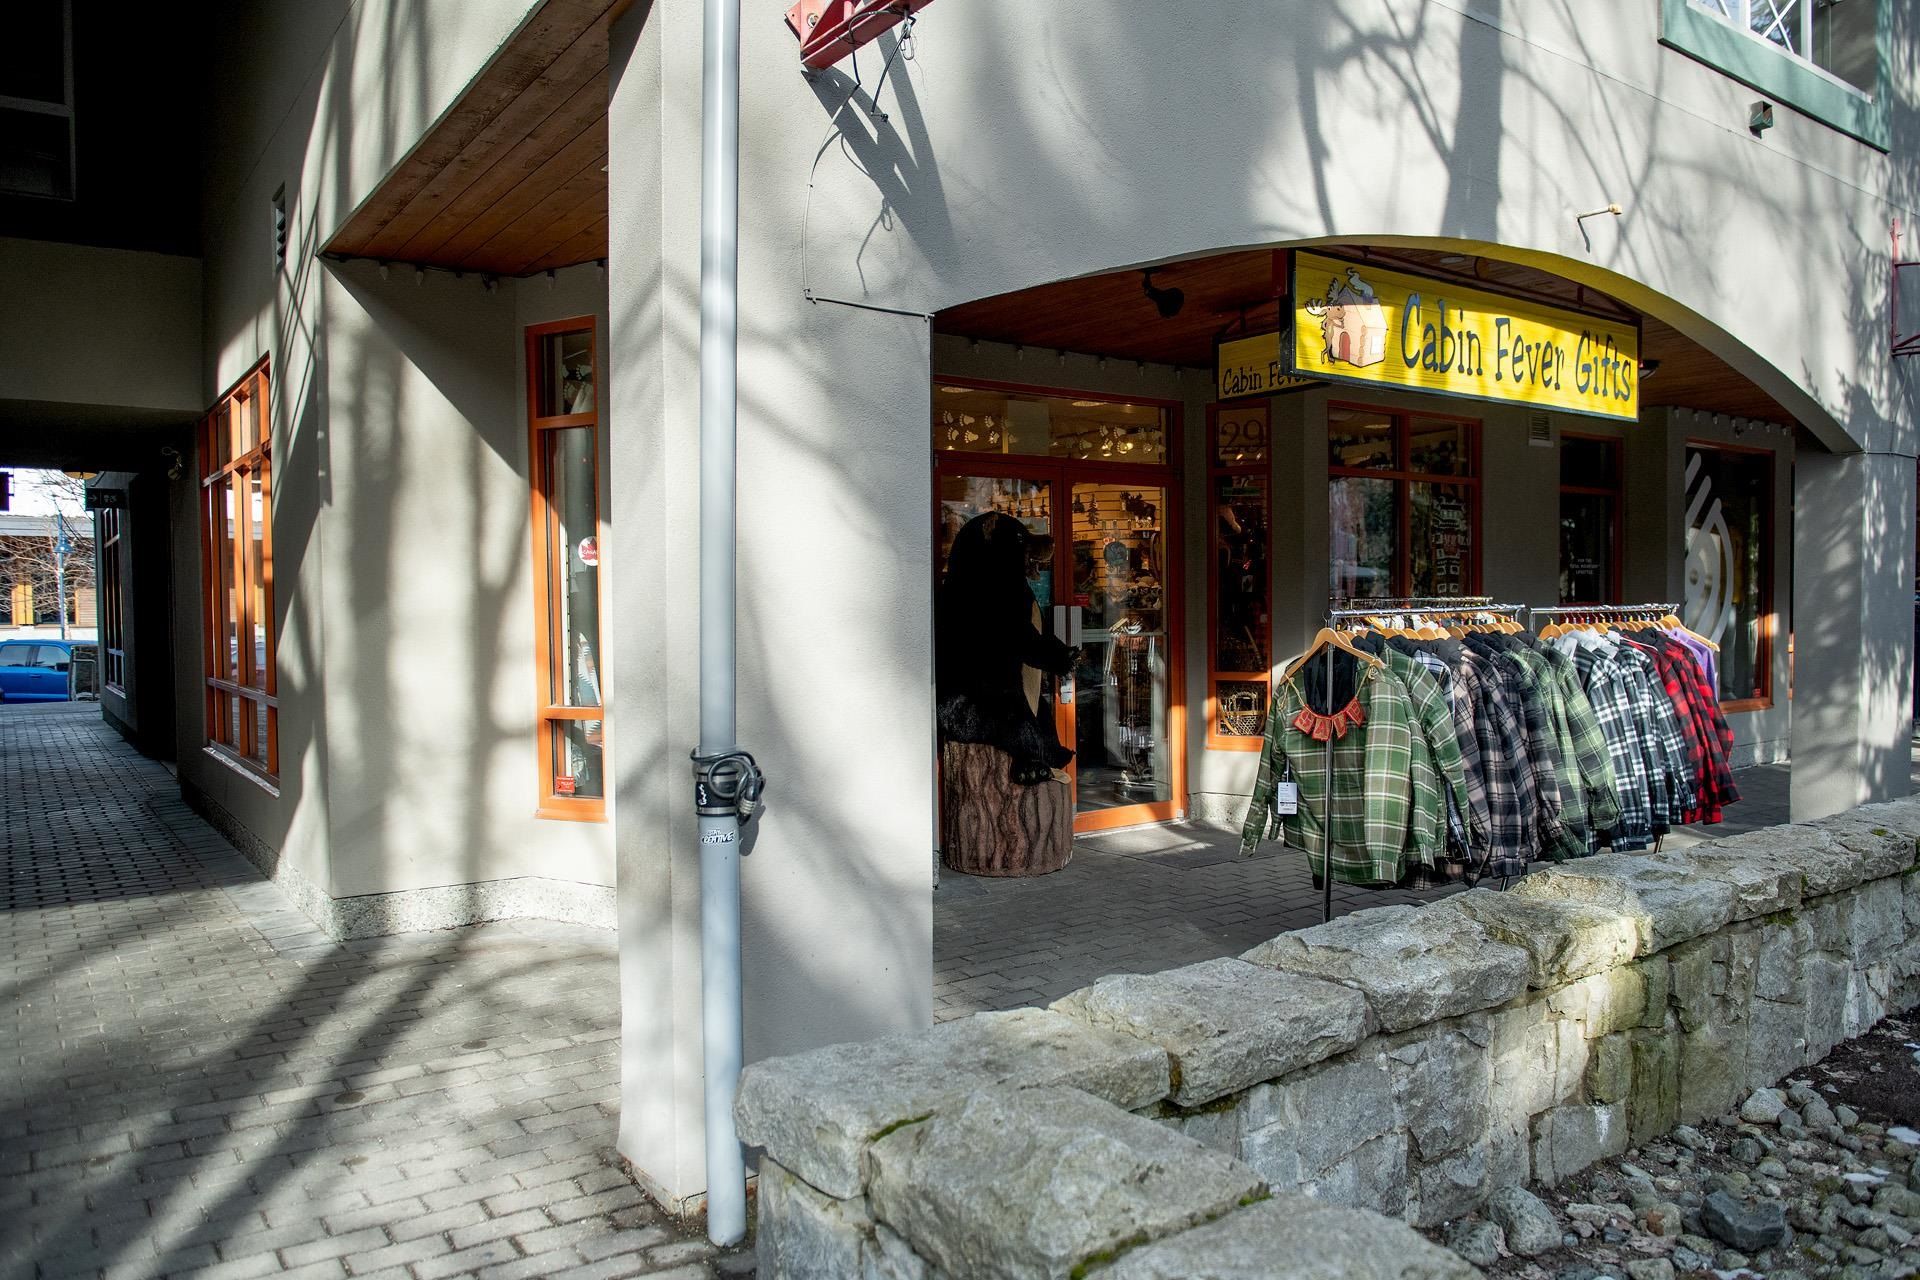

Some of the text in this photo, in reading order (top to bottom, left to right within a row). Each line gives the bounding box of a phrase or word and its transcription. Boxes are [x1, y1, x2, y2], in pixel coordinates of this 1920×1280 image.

[1401, 292, 1631, 401] Cabin Fever Gifts
[1222, 366, 1263, 395] Cabin
[1221, 420, 1264, 455] 29
